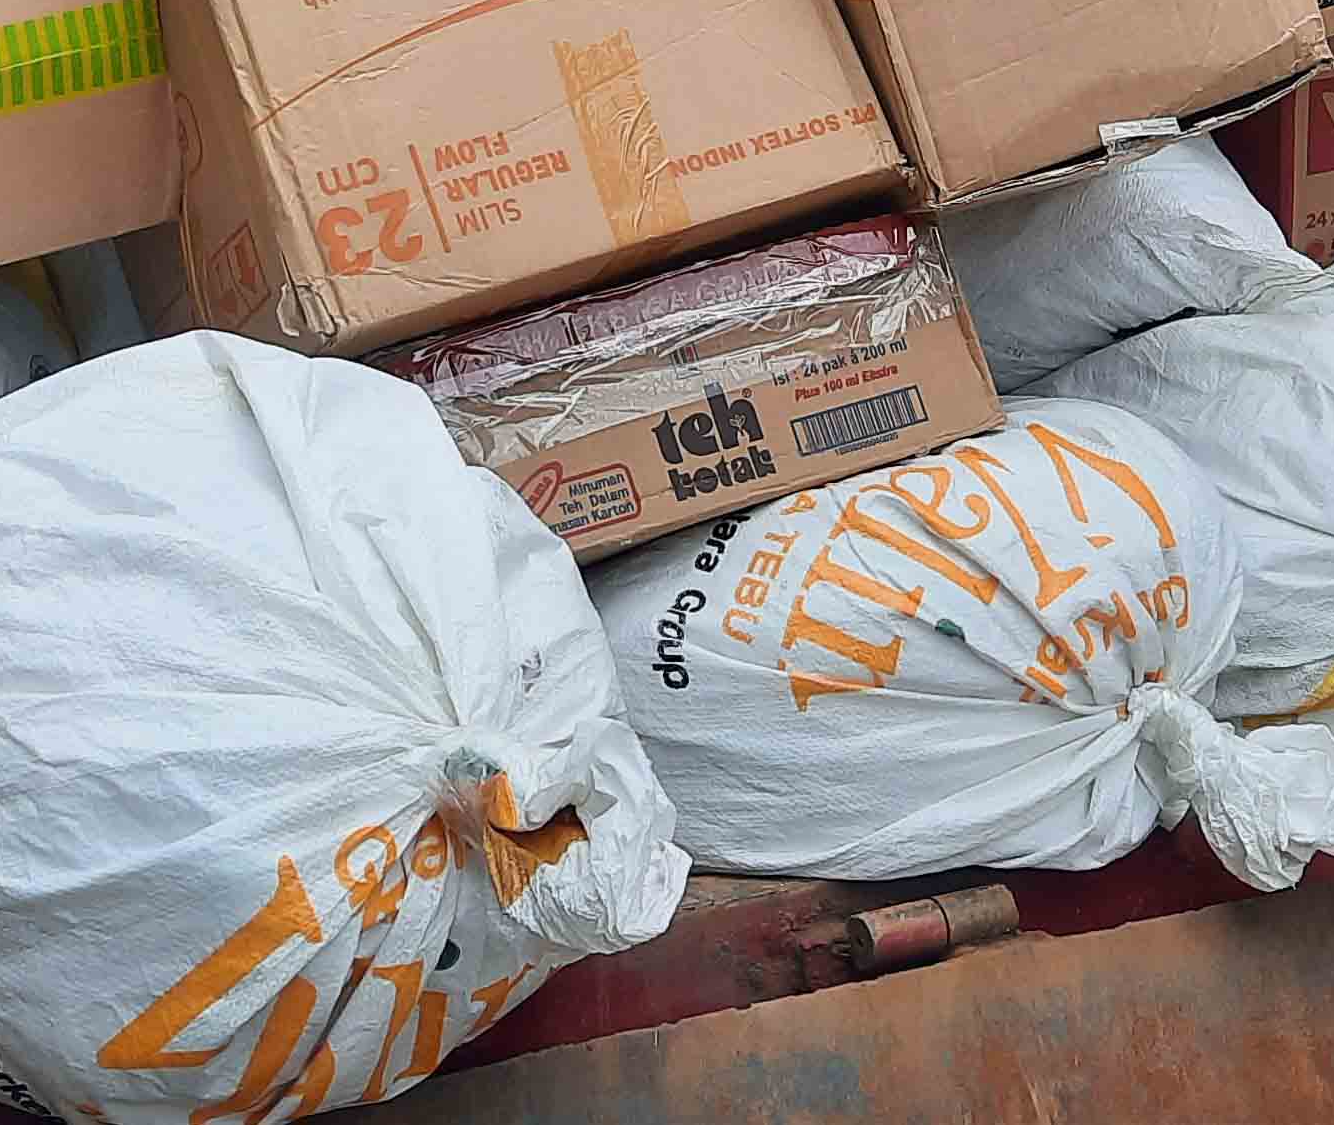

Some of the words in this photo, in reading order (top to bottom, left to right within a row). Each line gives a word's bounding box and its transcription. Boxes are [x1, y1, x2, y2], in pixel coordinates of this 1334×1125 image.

[752, 110, 836, 151] SOFTEX
[839, 102, 878, 130] PT.
[433, 131, 509, 171] FLOW
[315, 156, 379, 193] cm
[438, 148, 571, 202] REGULAR
[317, 186, 425, 275] 23
[455, 195, 523, 234] SLIM
[772, 371, 790, 387] Isi
[803, 362, 819, 379] 24
[821, 355, 848, 375] pak
[862, 343, 887, 363] 200
[889, 337, 908, 355] ml
[795, 386, 821, 404] Plus
[823, 379, 843, 394] 100
[845, 373, 860, 389] ml
[651, 380, 766, 466] teh
[568, 473, 626, 499] Minuman
[667, 445, 778, 503] kotak
[558, 499, 584, 518] Teh
[590, 488, 630, 508] Dalam
[590, 501, 636, 524] Karton
[721, 528, 804, 646] TEBU
[652, 588, 707, 690] Group
